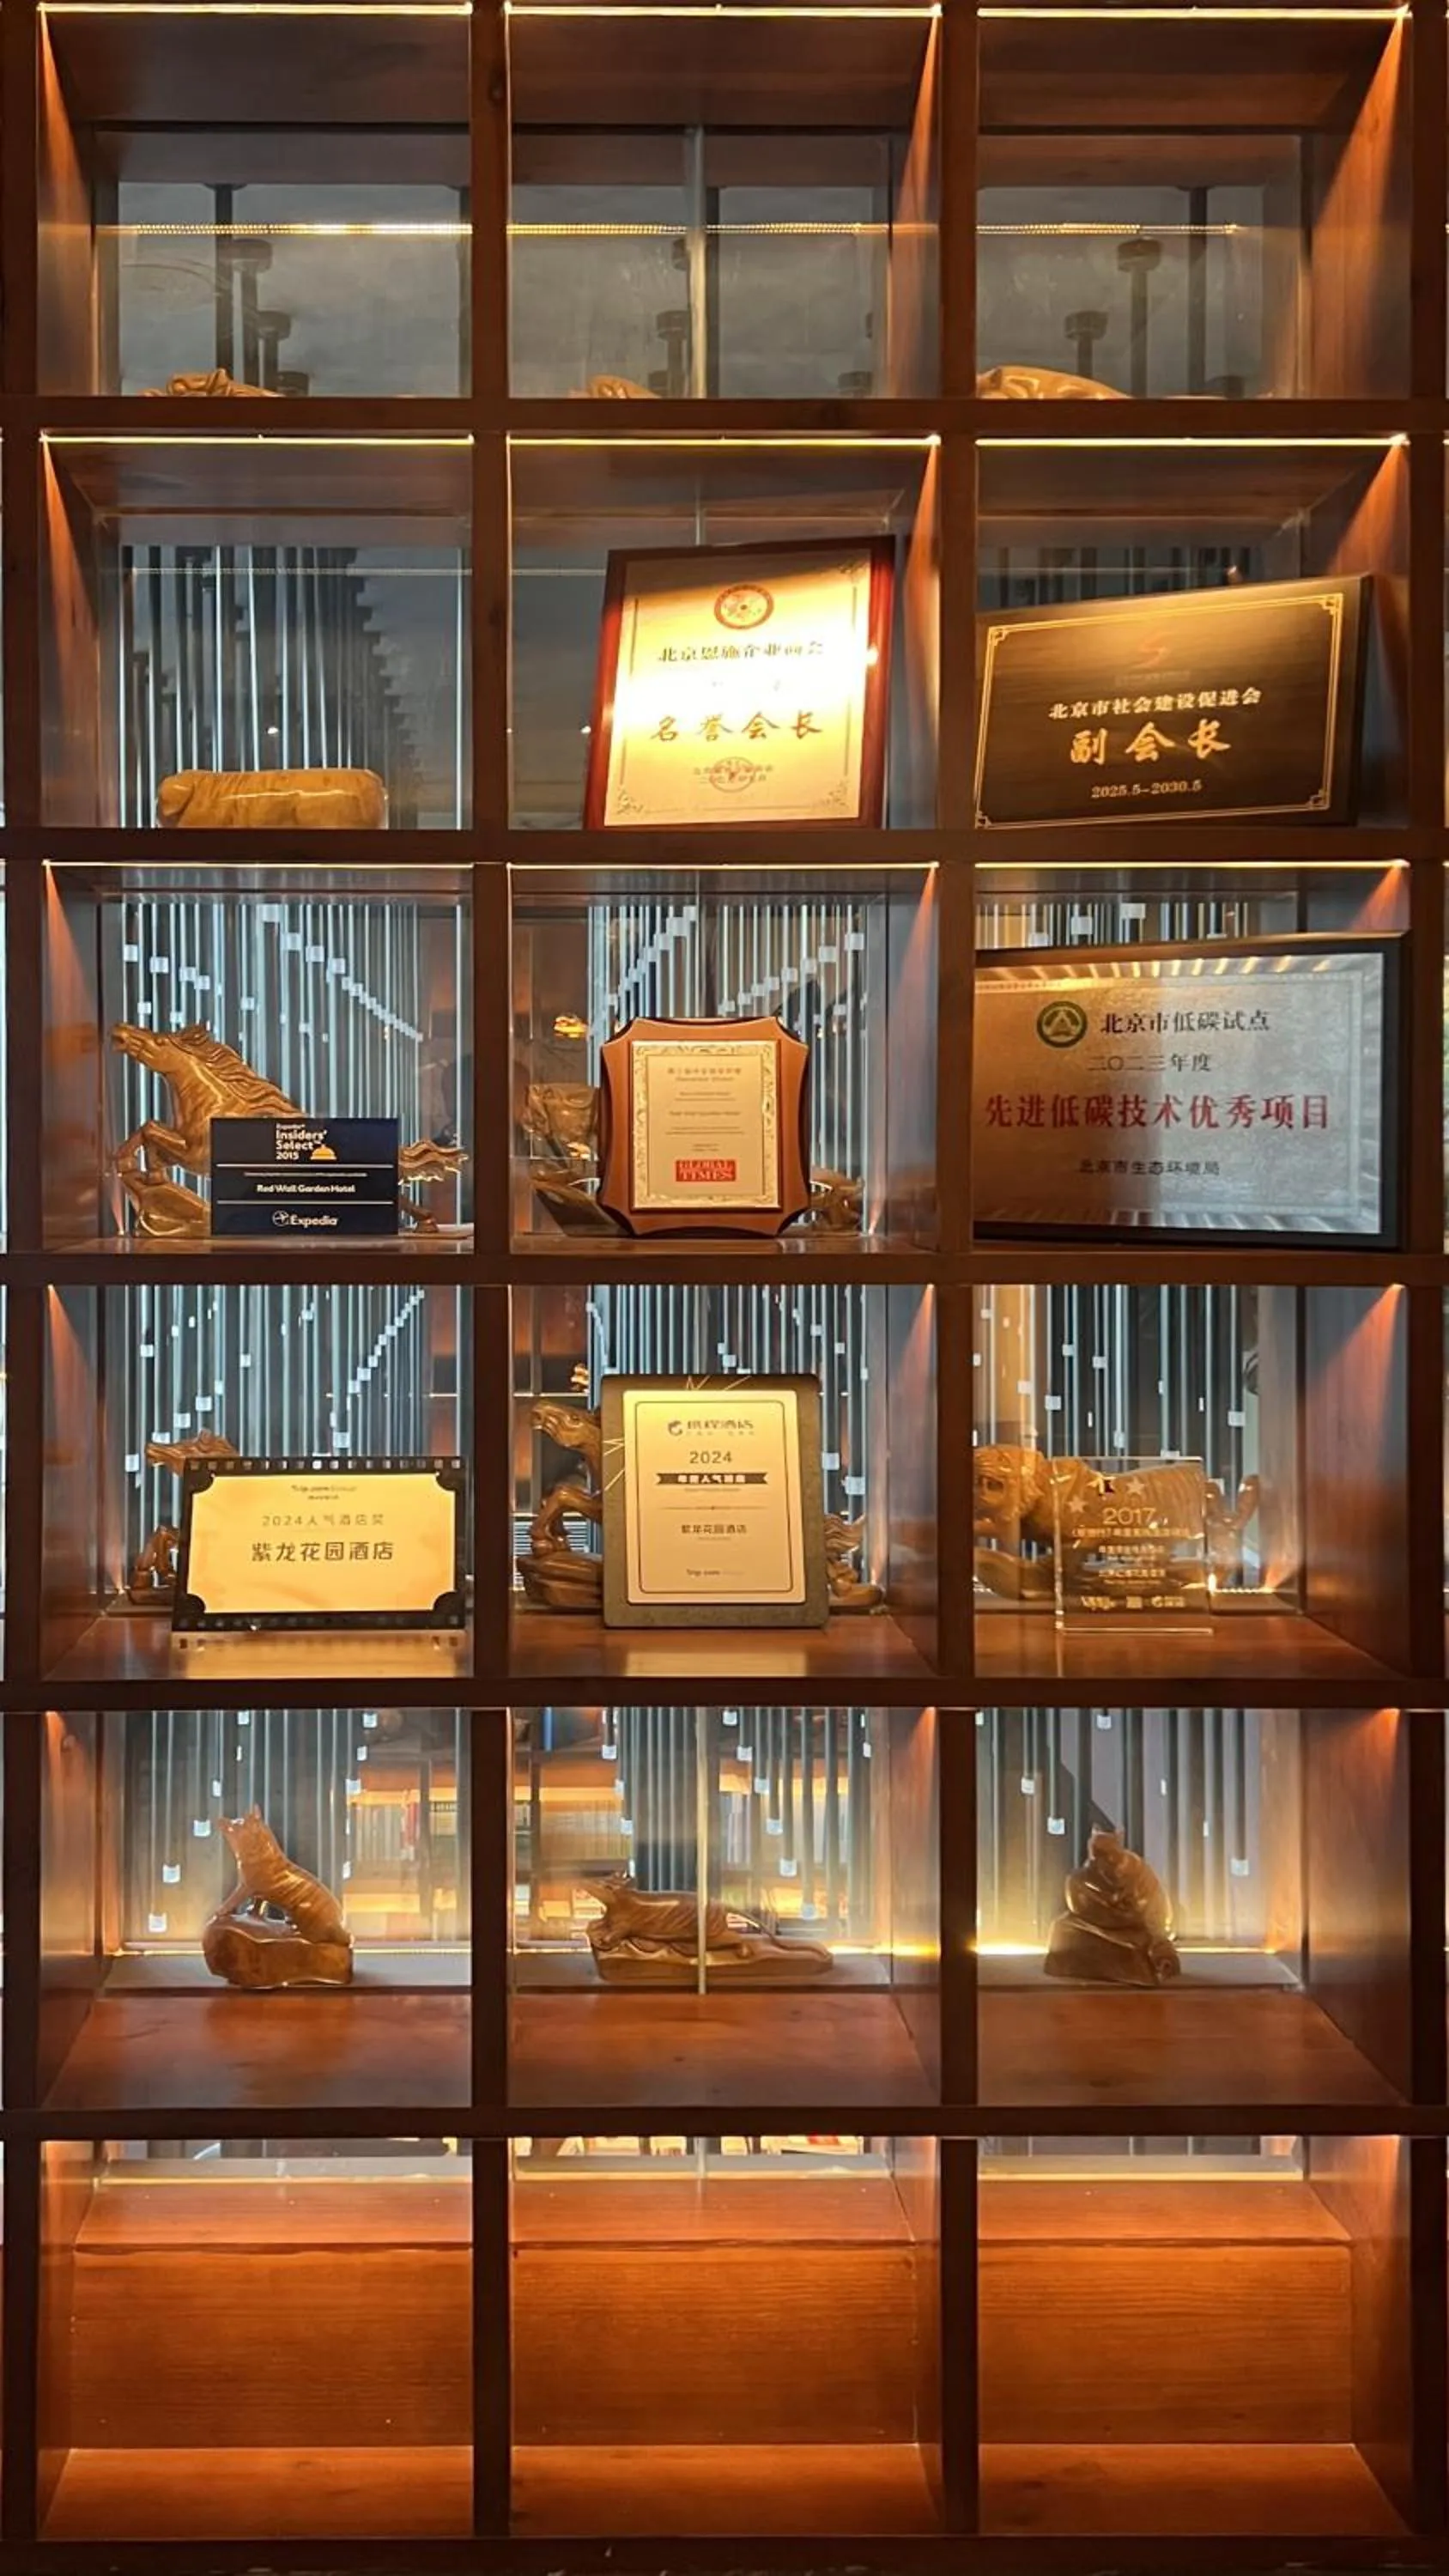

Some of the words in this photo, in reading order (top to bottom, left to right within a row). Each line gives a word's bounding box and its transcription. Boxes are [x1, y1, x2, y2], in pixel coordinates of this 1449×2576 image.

[1049, 687, 1262, 720] 北京市社会建设促进会
[651, 710, 822, 742] 名誉会长
[1070, 719, 1231, 764] 副会长
[1100, 1010, 1270, 1034] 北京市低碳试点
[985, 1094, 1329, 1130] 先进低碳技术优秀项目
[679, 1170, 733, 1181] TIMES
[257, 1184, 274, 1193] Red
[275, 1184, 297, 1193] Wall
[298, 1184, 330, 1193] Garden
[330, 1184, 355, 1193] Hotel
[290, 1214, 339, 1229] Expedia
[689, 1450, 732, 1464] 2024
[1102, 1507, 1157, 1525] 2017
[252, 1541, 394, 1561] 紫龙花园酒店
